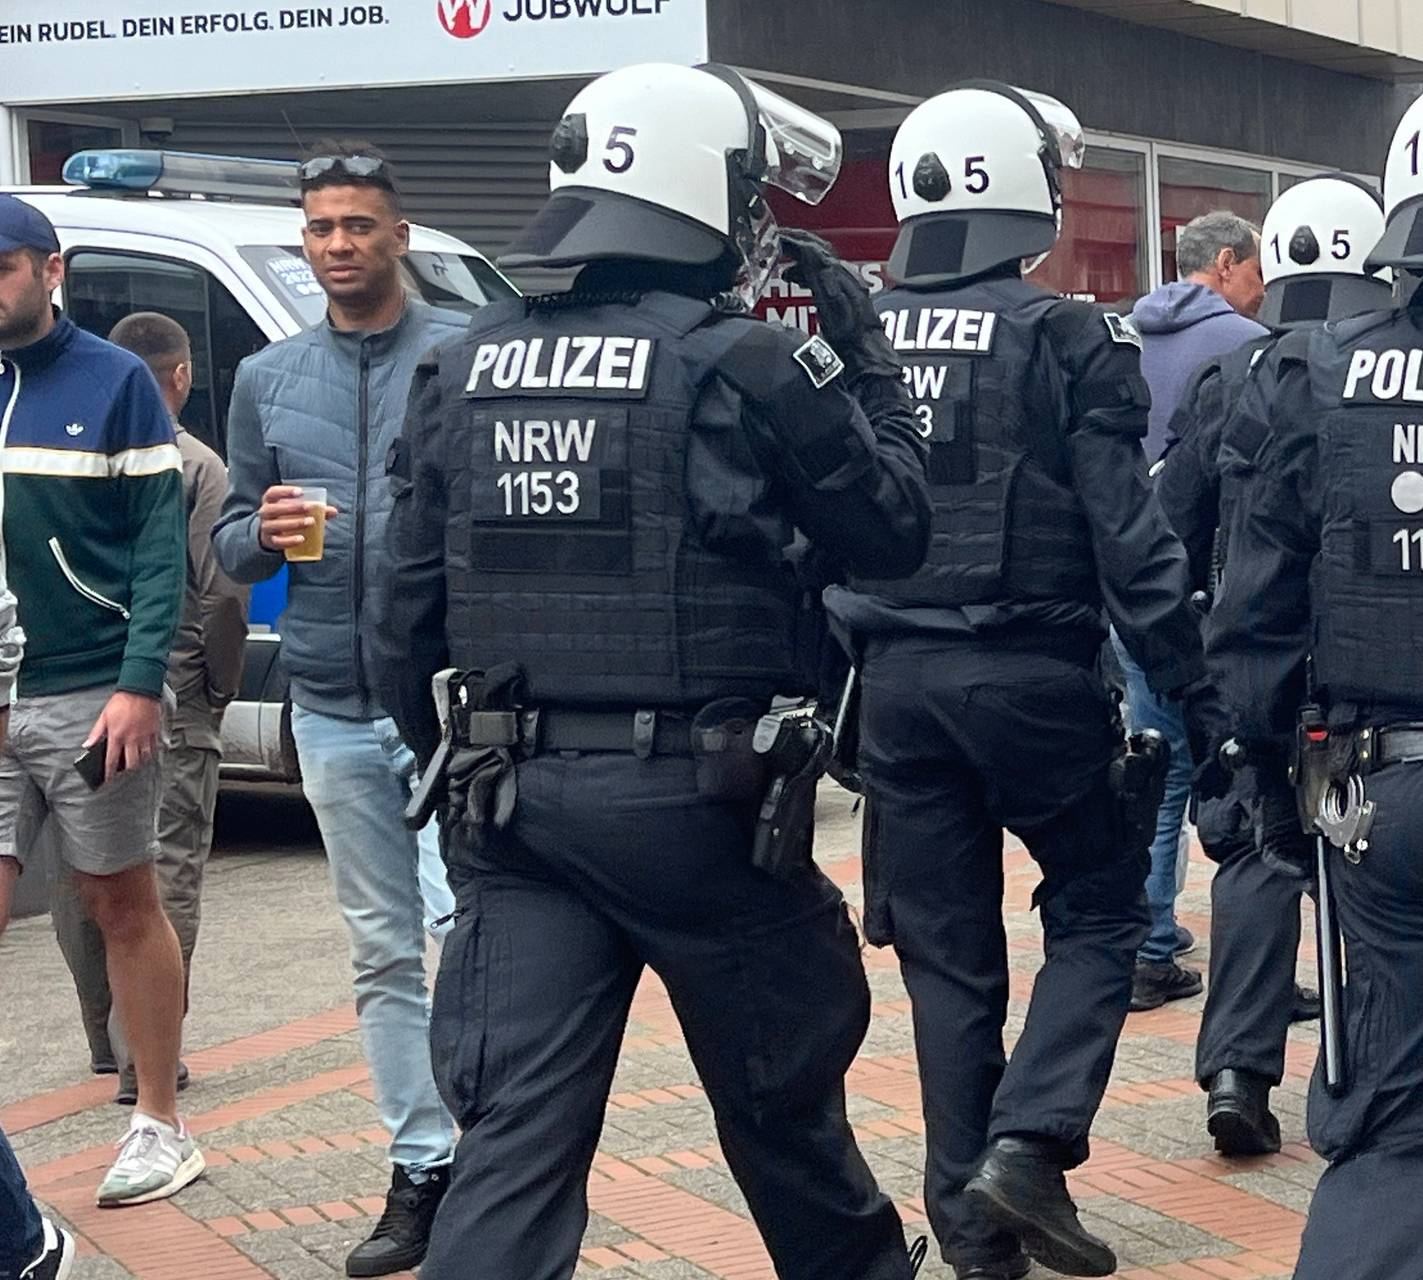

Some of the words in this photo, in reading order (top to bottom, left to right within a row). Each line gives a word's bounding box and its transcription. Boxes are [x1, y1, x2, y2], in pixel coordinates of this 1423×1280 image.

[122, 17, 174, 38] DEIN
[180, 11, 274, 35] ERFOLG.
[280, 8, 332, 29] DEIN
[338, 6, 389, 26] JOB.
[602, 125, 637, 174] 5
[1404, 130, 1420, 176] 1
[895, 161, 907, 199] 1
[964, 155, 990, 194] 5
[1270, 233, 1281, 265] 1
[1331, 229, 1351, 260] 5
[465, 336, 651, 392] POLIZEI
[494, 419, 596, 463] NRW
[497, 470, 580, 516] 1153
